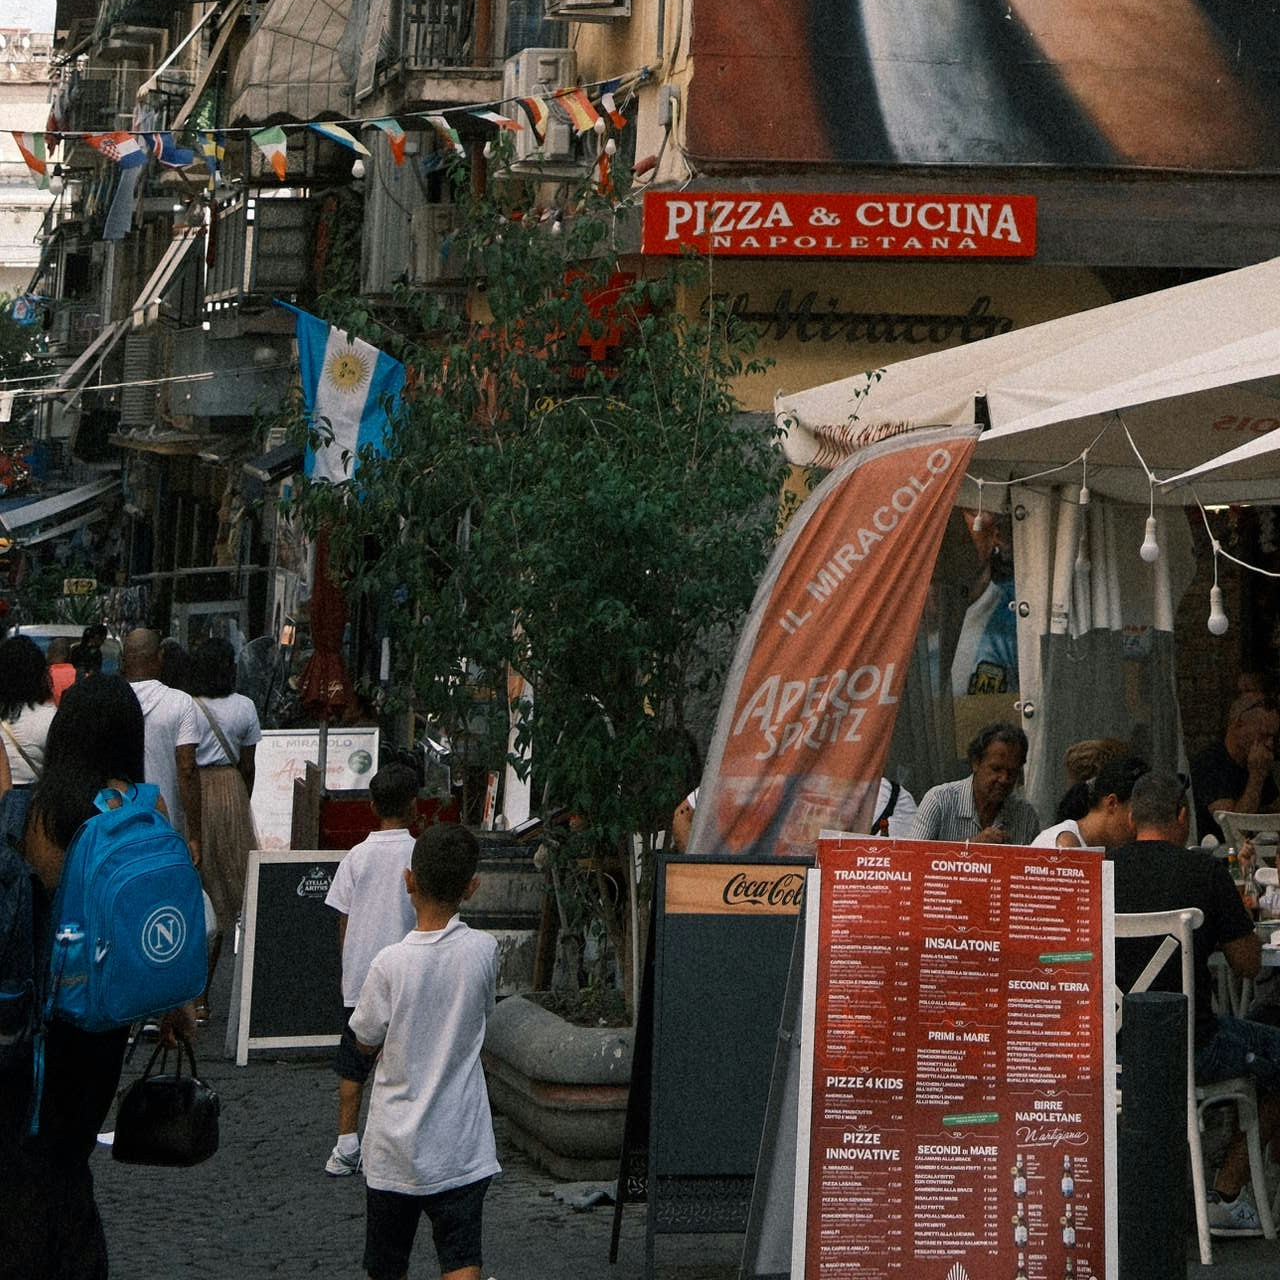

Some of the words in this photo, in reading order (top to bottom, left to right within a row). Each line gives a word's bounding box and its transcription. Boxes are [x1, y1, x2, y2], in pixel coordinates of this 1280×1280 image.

[665, 200, 793, 241] PIZZA
[809, 207, 841, 226] &
[856, 202, 1022, 243] CUCINA
[712, 236, 978, 249] NAPOLETANA
[779, 609, 812, 635] IL
[806, 447, 952, 603] MIRACOLO
[733, 662, 898, 736] APEROL
[286, 739, 352, 749] MIRAOLO
[857, 857, 891, 867] PIZZE
[931, 860, 992, 874] CONTORNI
[834, 870, 912, 882] TRADIZIONALI
[1025, 866, 1048, 875] PRIMI
[1056, 867, 1085, 877] TERRA
[723, 873, 804, 907] Coca-Col
[155, 919, 174, 949] N
[925, 937, 1001, 952] INSALATONE
[1008, 980, 1049, 990] SECONDI
[1058, 982, 1090, 992] TERRA
[928, 1031, 954, 1041] PRIMI
[963, 1032, 991, 1043] MARE
[827, 1077, 864, 1089] PIZZE
[866, 1078, 873, 1089] 4
[875, 1079, 904, 1089] KIDS
[1034, 1100, 1063, 1110] BIRRE
[1015, 1112, 1082, 1122] NAPOLETANE
[843, 1133, 881, 1144] PIZZE
[826, 1148, 900, 1161] INNOVATIVE
[918, 1145, 961, 1155] SECONDI
[970, 1146, 999, 1156] MARE
